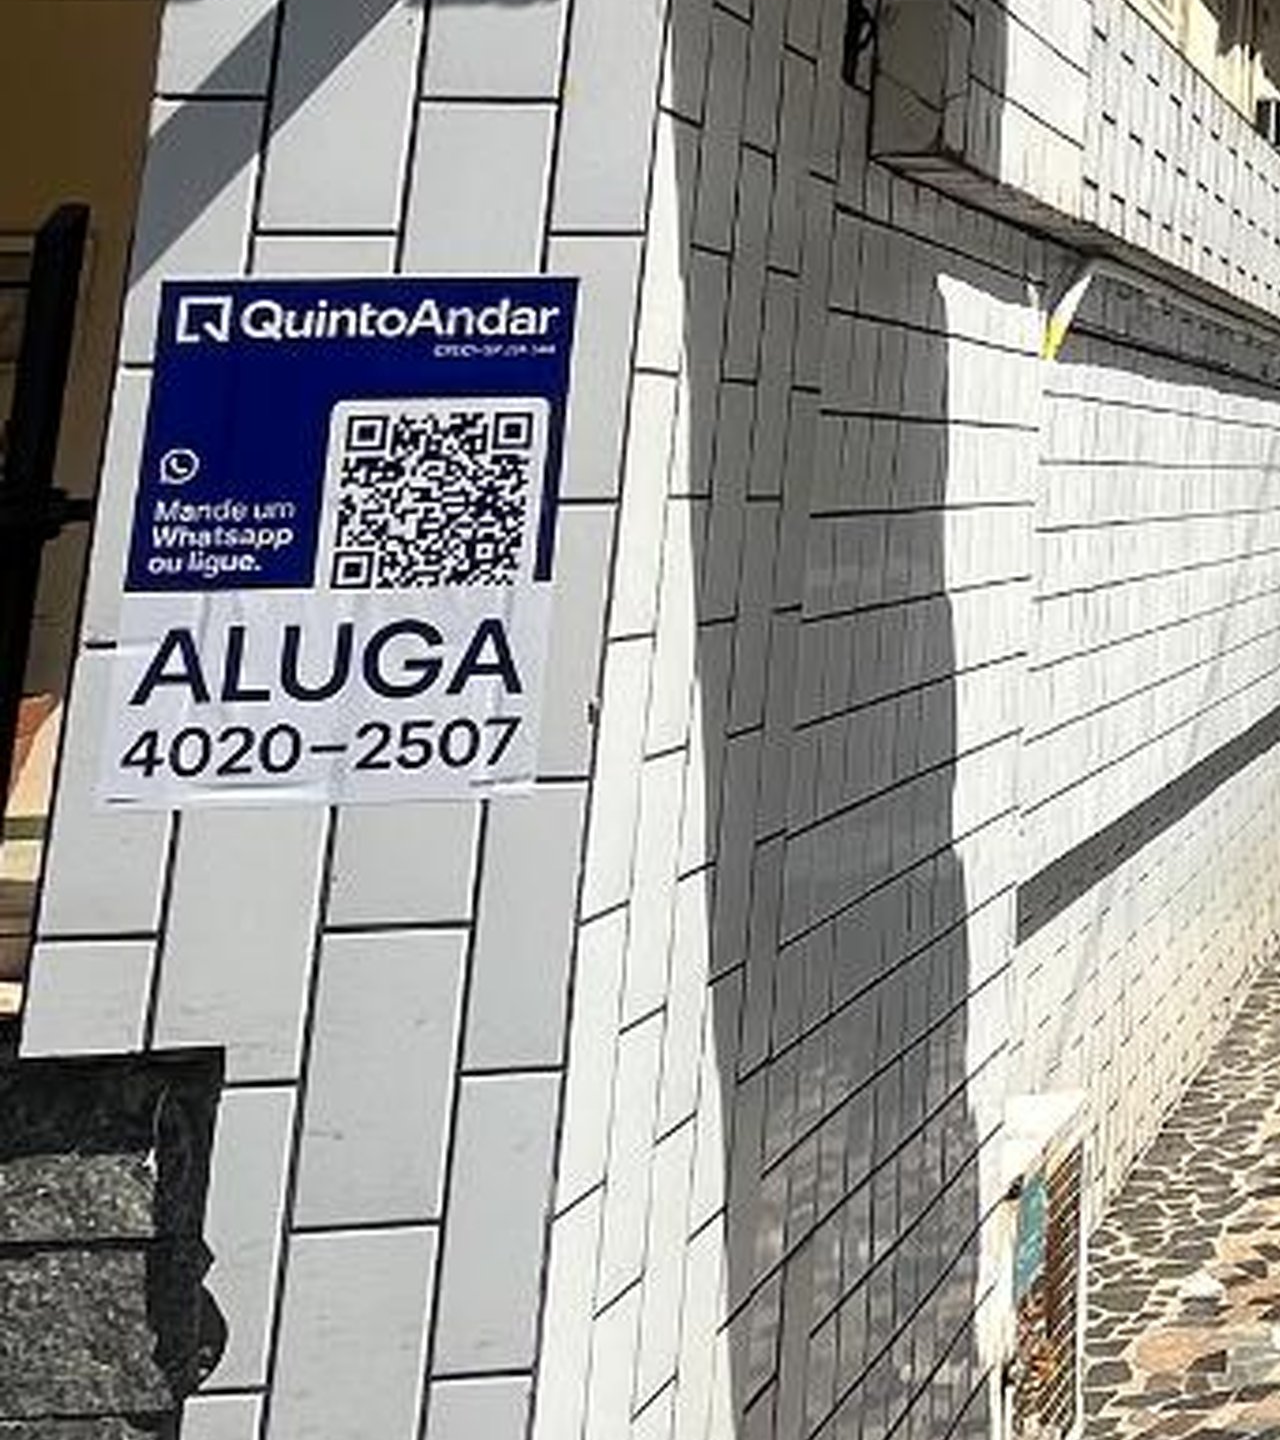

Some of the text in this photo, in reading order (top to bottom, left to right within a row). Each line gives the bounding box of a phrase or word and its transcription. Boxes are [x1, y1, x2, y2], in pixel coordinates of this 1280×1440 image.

[240, 298, 560, 341] QuintoAndar
[153, 498, 297, 522] Mande um
[152, 524, 294, 551] Whatsapp
[148, 550, 262, 579] ou ligue.
[128, 618, 523, 706] ALUGA
[120, 716, 523, 778] 4020-2507
